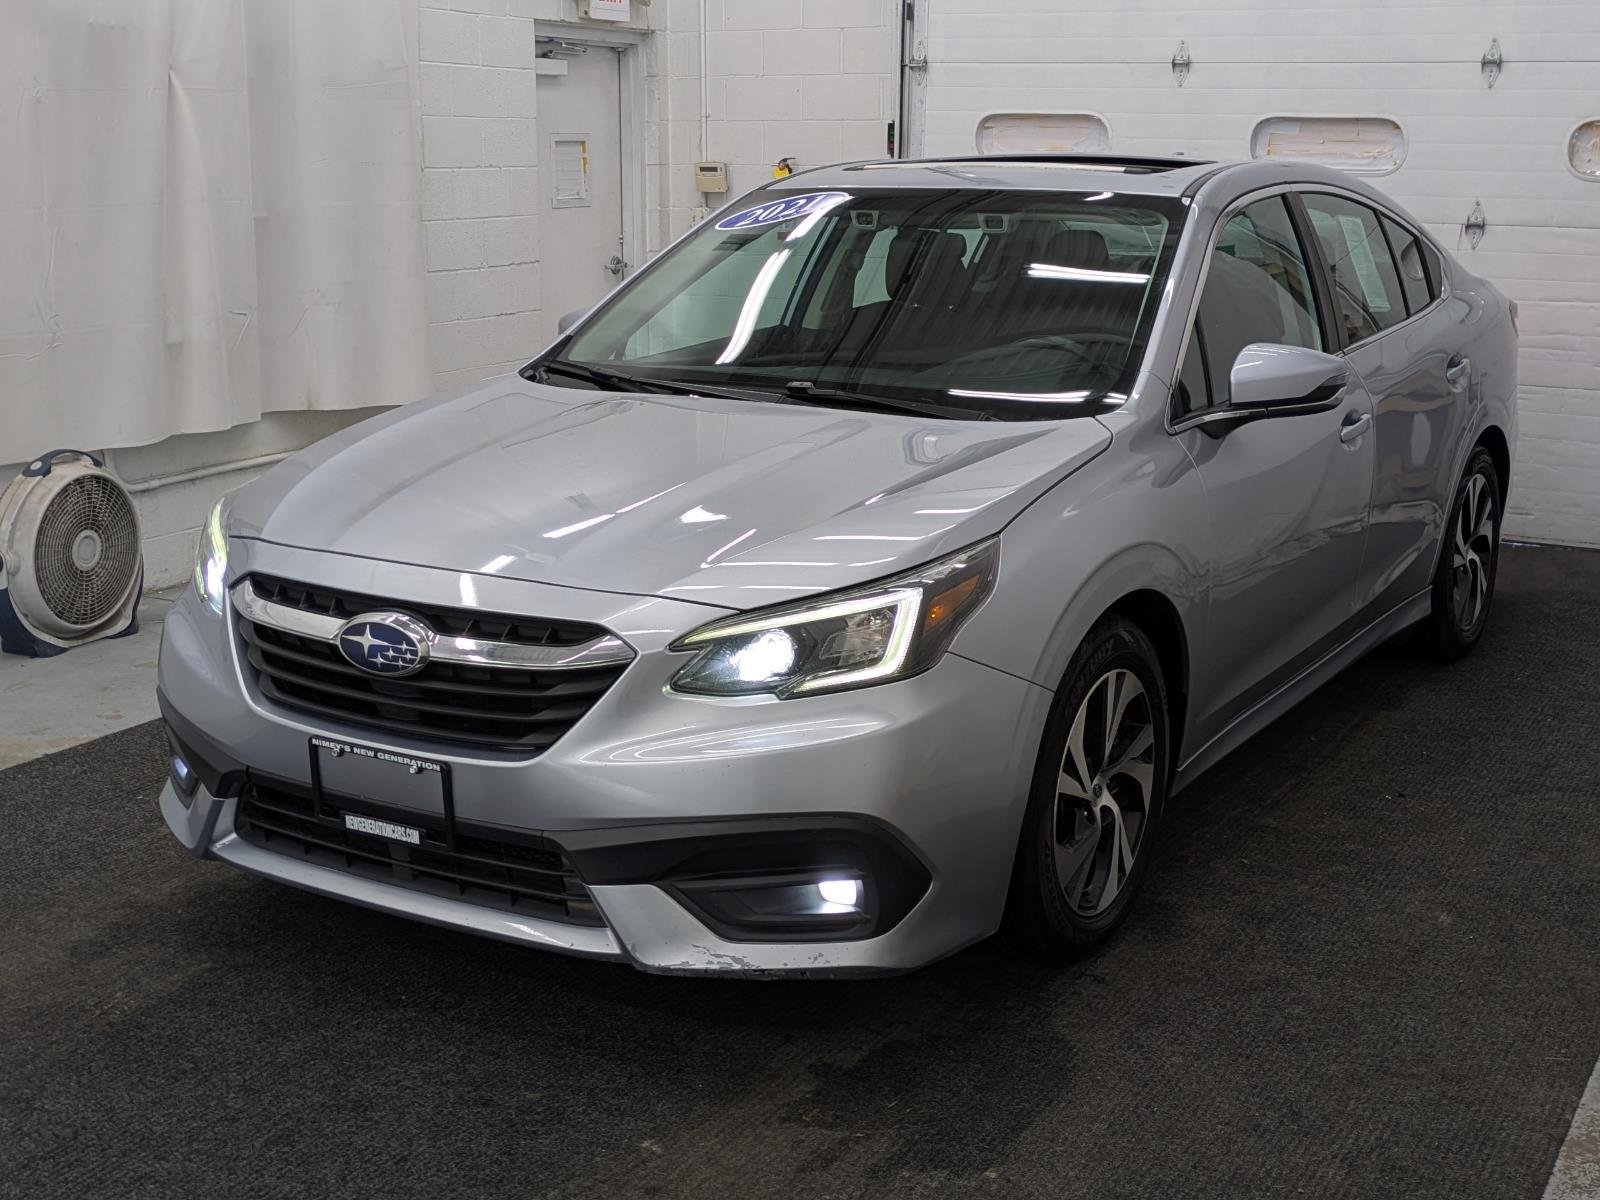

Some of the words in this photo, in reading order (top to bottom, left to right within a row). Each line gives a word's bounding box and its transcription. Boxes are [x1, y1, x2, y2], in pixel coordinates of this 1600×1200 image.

[311, 738, 352, 752] NIMEY'S
[353, 747, 375, 758] NEW
[377, 752, 441, 772] GENERATION
